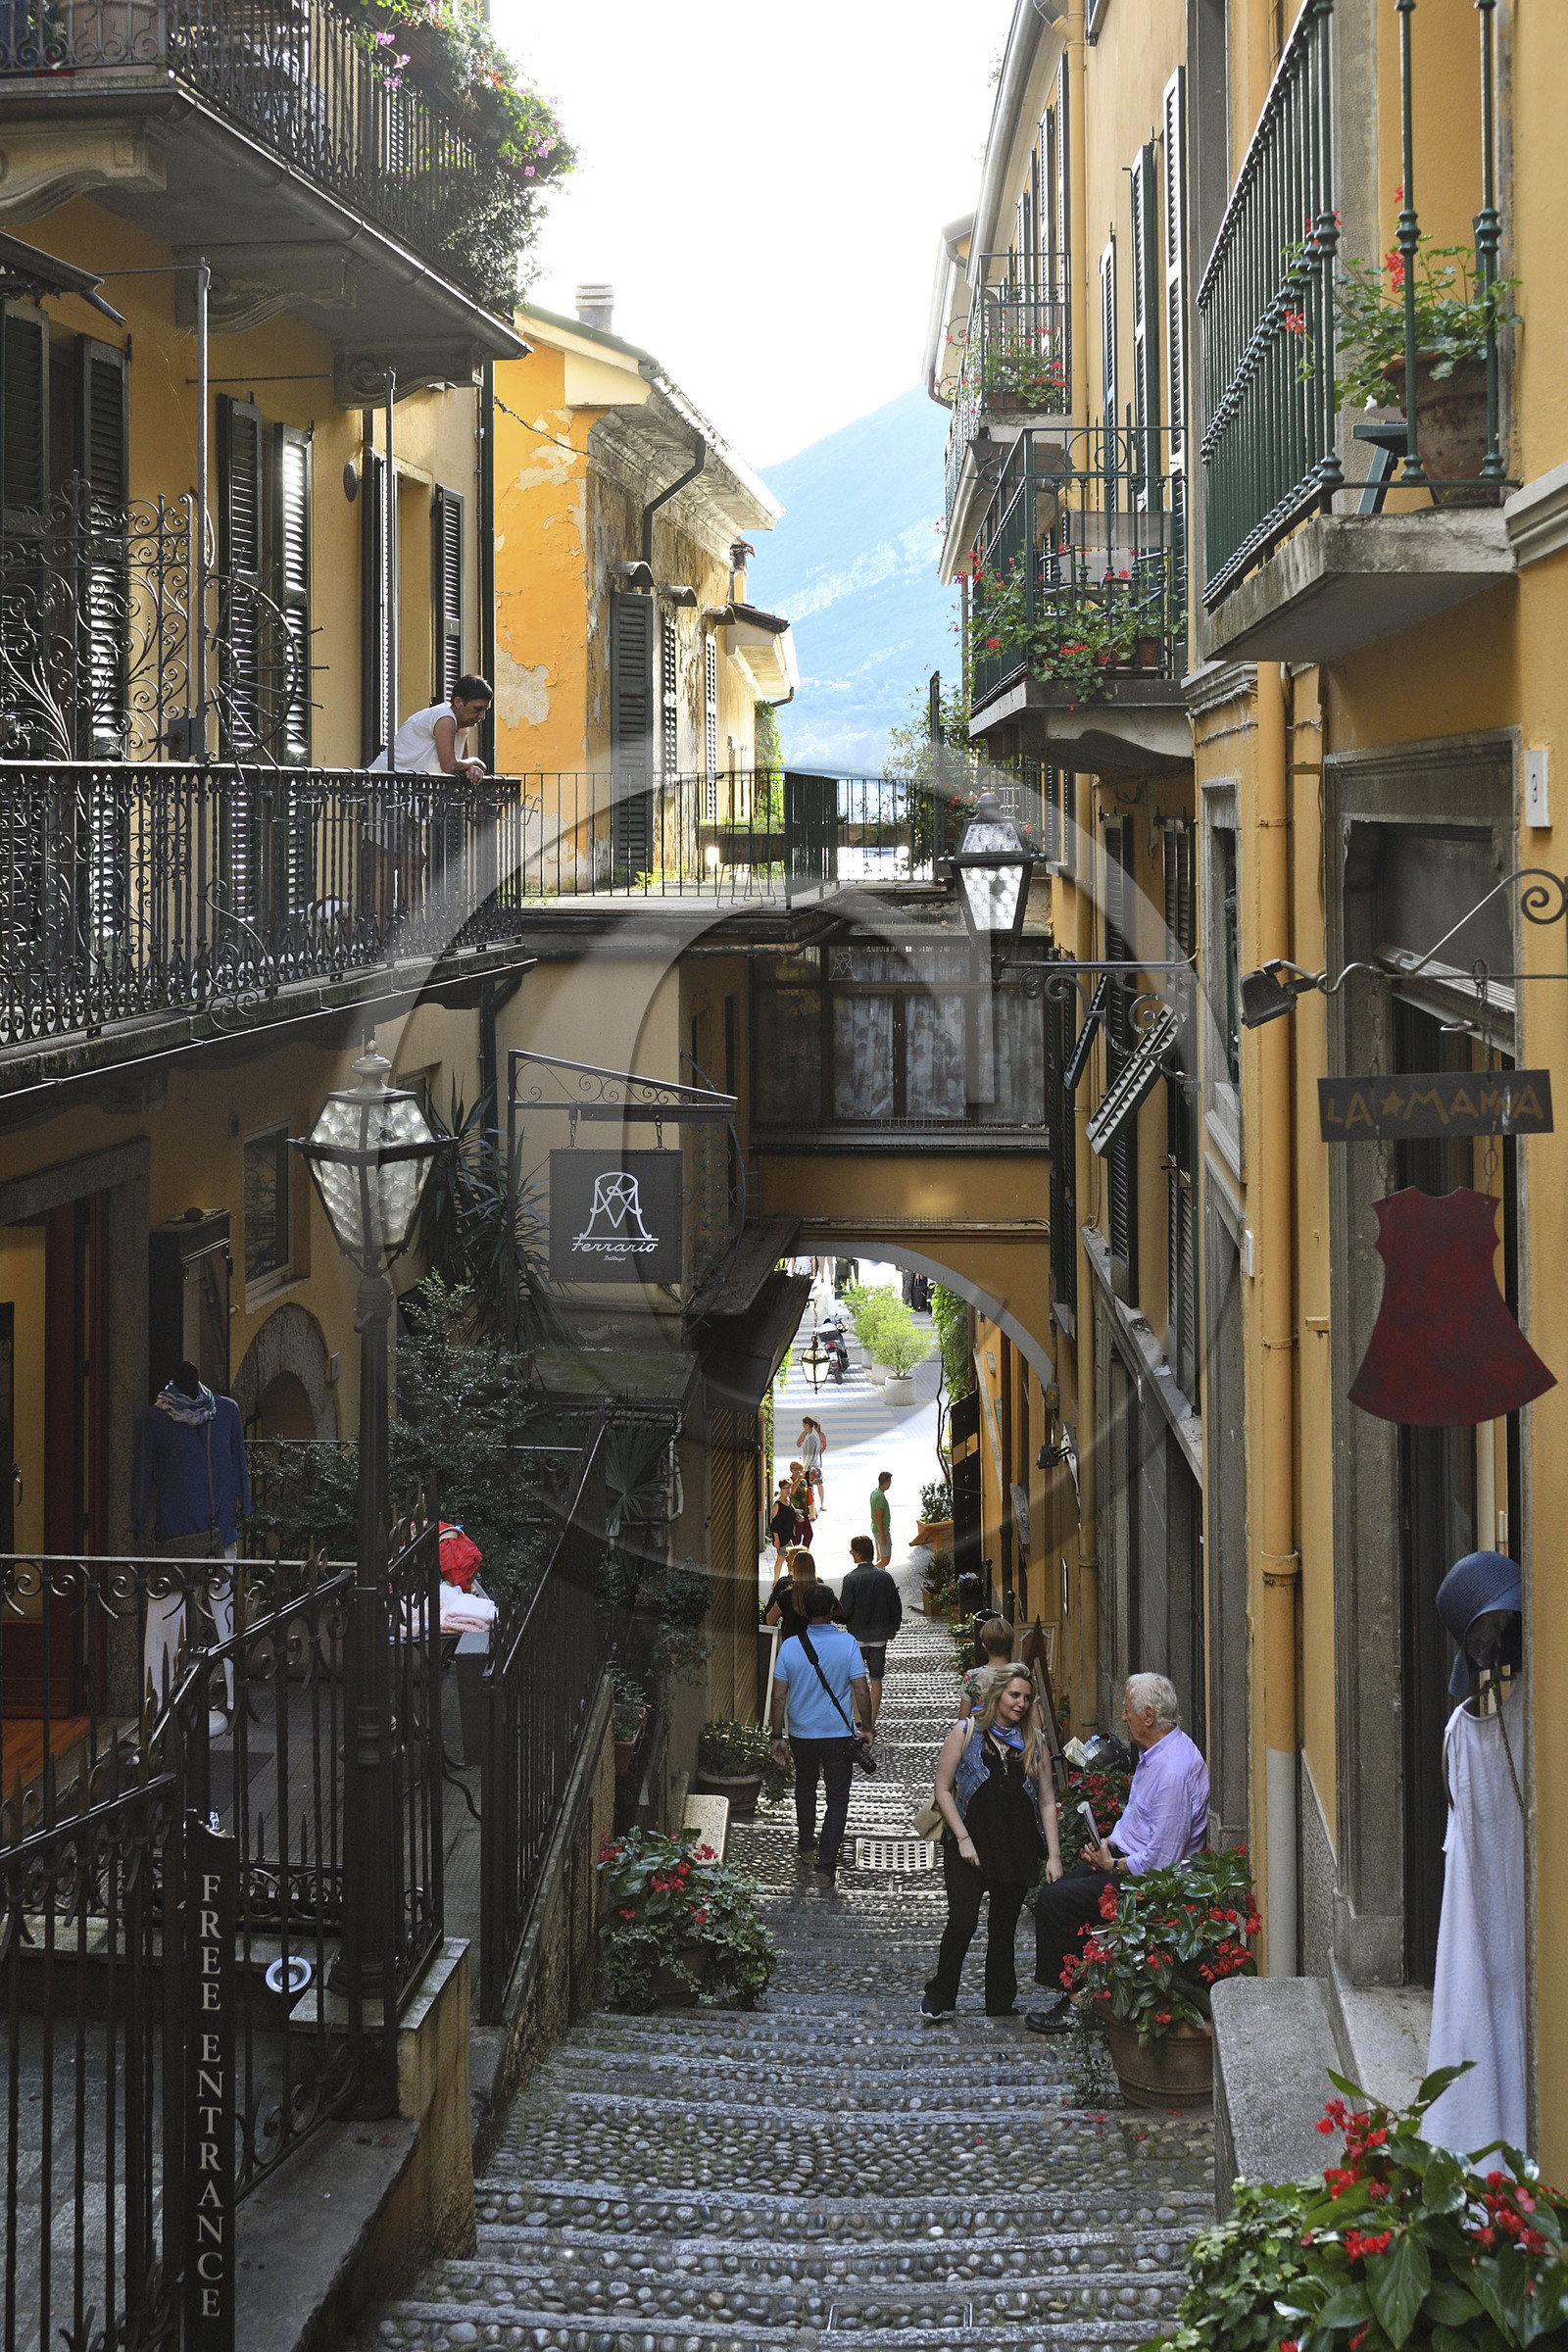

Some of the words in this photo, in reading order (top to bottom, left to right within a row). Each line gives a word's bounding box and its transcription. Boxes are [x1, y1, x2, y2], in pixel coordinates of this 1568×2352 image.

[1531, 773, 1538, 803] 9
[1326, 1091, 1372, 1128] LA
[571, 1238, 659, 1252] Ferrario
[199, 1874, 222, 2012] FREE
[196, 2034, 224, 2318] ENTRANCE
